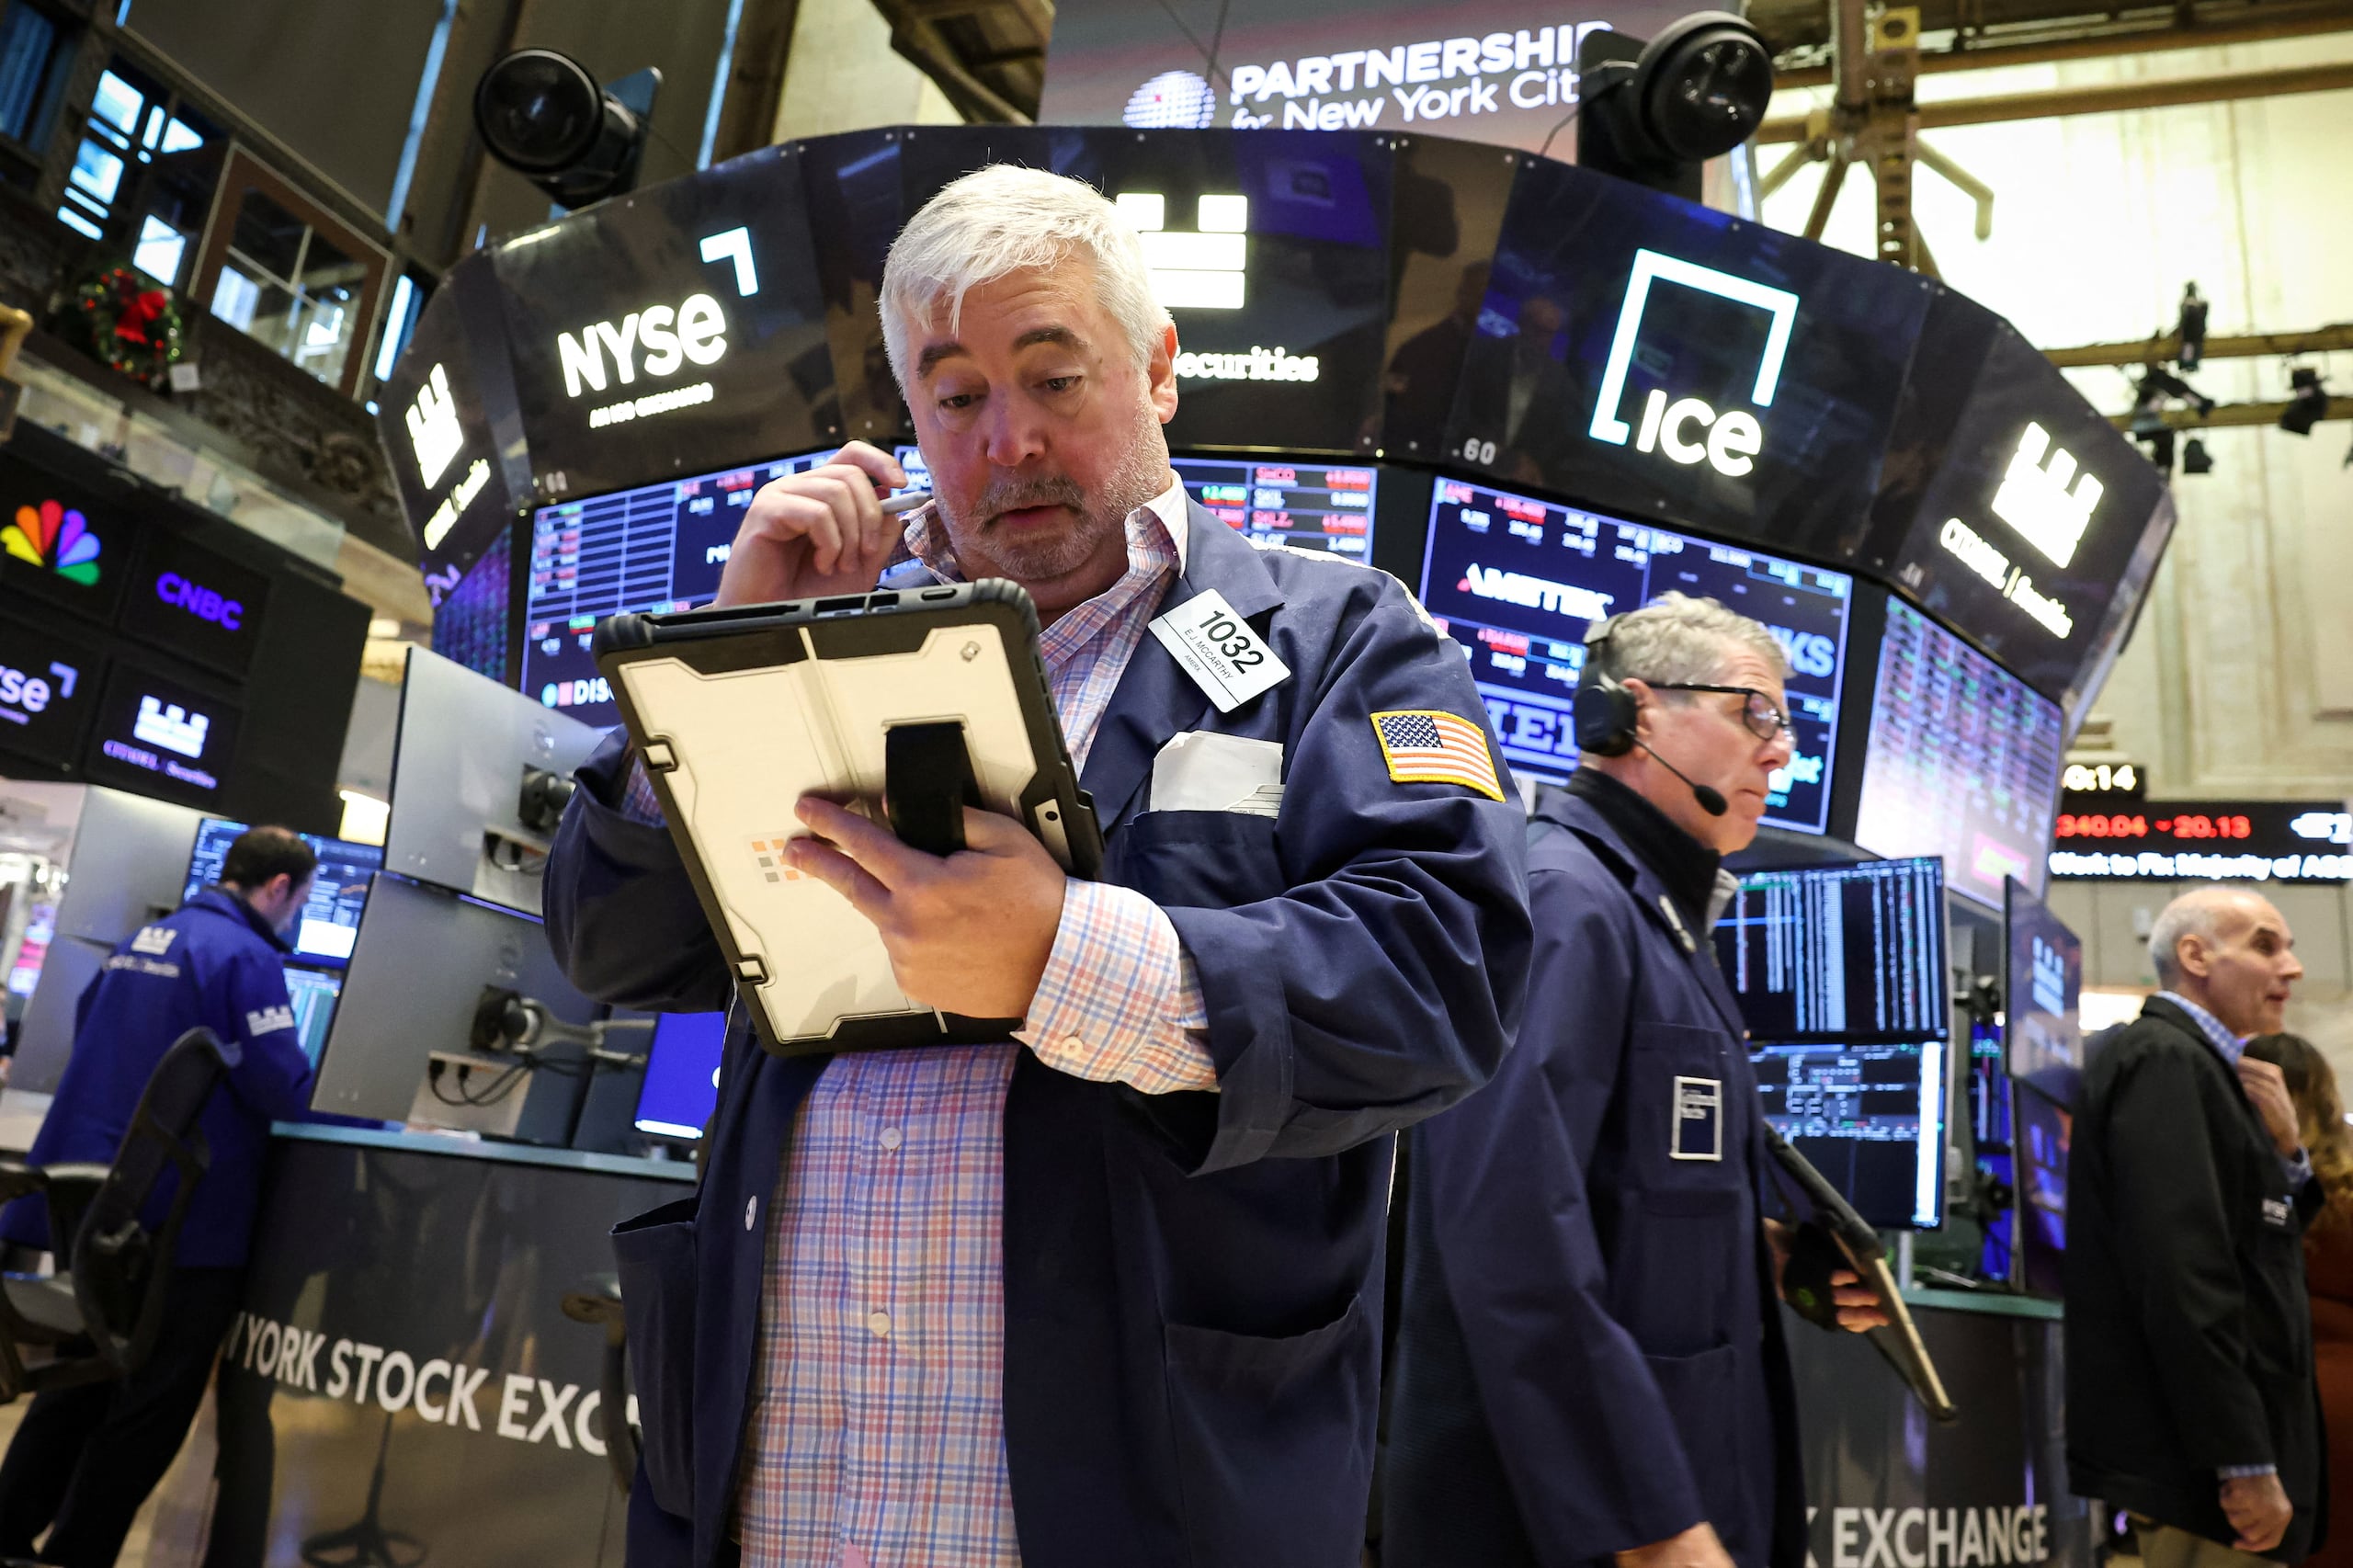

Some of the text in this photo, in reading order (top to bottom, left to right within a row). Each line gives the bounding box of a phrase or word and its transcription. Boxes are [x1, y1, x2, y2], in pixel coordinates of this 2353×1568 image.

[1282, 97, 1384, 131] New
[1392, 76, 1500, 123] York
[1508, 67, 1581, 109] Cit
[1172, 345, 1319, 382] ecurities
[1463, 437, 1496, 465] 60
[156, 571, 244, 631] CNBC
[1196, 641, 1233, 679] MCCARTHY
[1199, 610, 1264, 675] 1032
[2063, 765, 2137, 791] 0:14
[244, 1312, 326, 1392] YORK
[326, 1337, 490, 1432] STOCK
[497, 1372, 641, 1456] EXC
[1833, 1503, 2050, 1568] EXCHANGE
